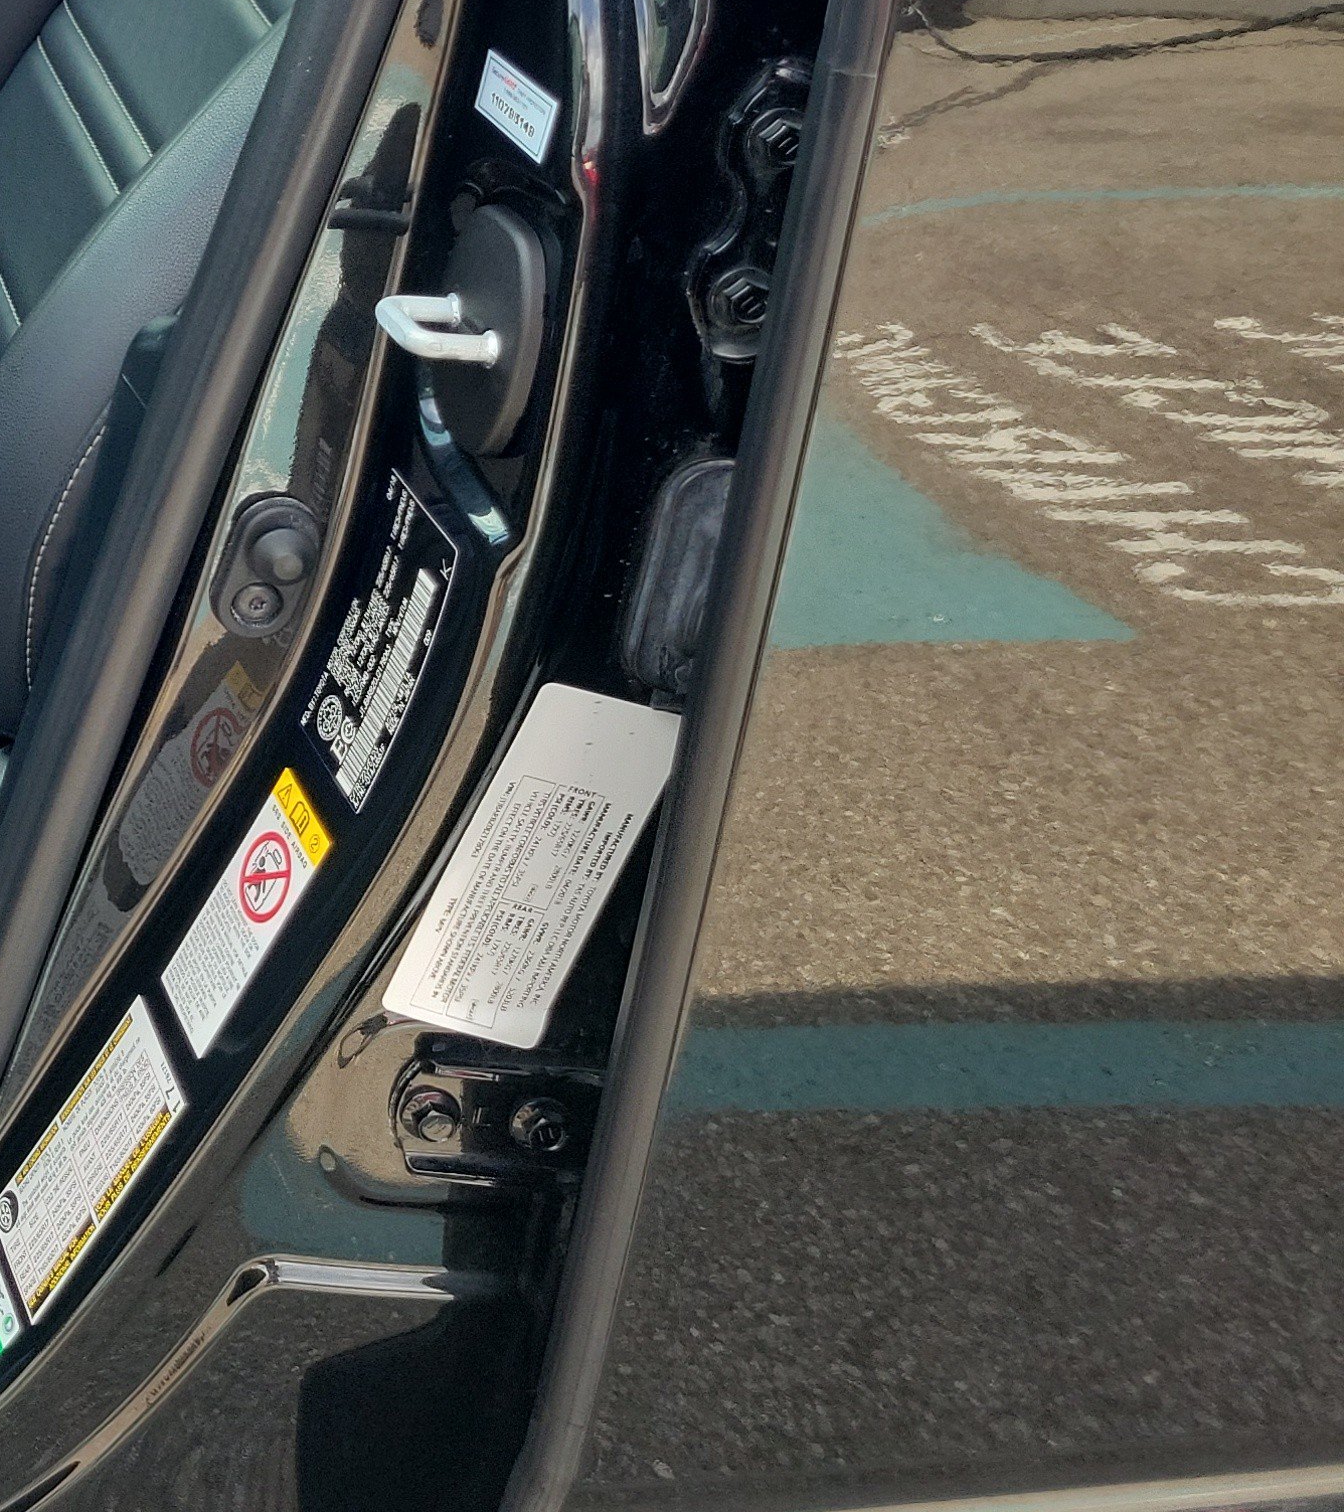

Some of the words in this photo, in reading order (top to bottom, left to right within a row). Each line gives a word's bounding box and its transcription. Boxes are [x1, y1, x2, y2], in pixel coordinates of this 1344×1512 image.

[438, 557, 452, 581] K
[567, 785, 596, 798] FRONT
[503, 802, 521, 827] EFFECT
[497, 826, 509, 838] ON
[549, 821, 572, 857] 225/65R17
[579, 801, 611, 855] MANUFACTURE
[279, 819, 292, 840] SIDE
[290, 838, 309, 870] AIRBAG
[490, 838, 503, 852] THE
[504, 834, 529, 872] CONFORMS
[588, 830, 612, 868] IMPORTED
[599, 812, 633, 871] MANUFACTURED
[481, 852, 496, 869] DATE
[568, 855, 584, 875] DATE:
[485, 872, 497, 888] AND
[498, 873, 509, 883] TO
[452, 880, 482, 930] MANUFACTURE
[511, 902, 533, 913] REAR
[563, 896, 578, 914] AUTO
[577, 885, 597, 912] TOYOTA
[473, 895, 498, 934] APPLICABLE
[563, 911, 582, 939] MOTOR
[551, 937, 569, 963] NORTH
